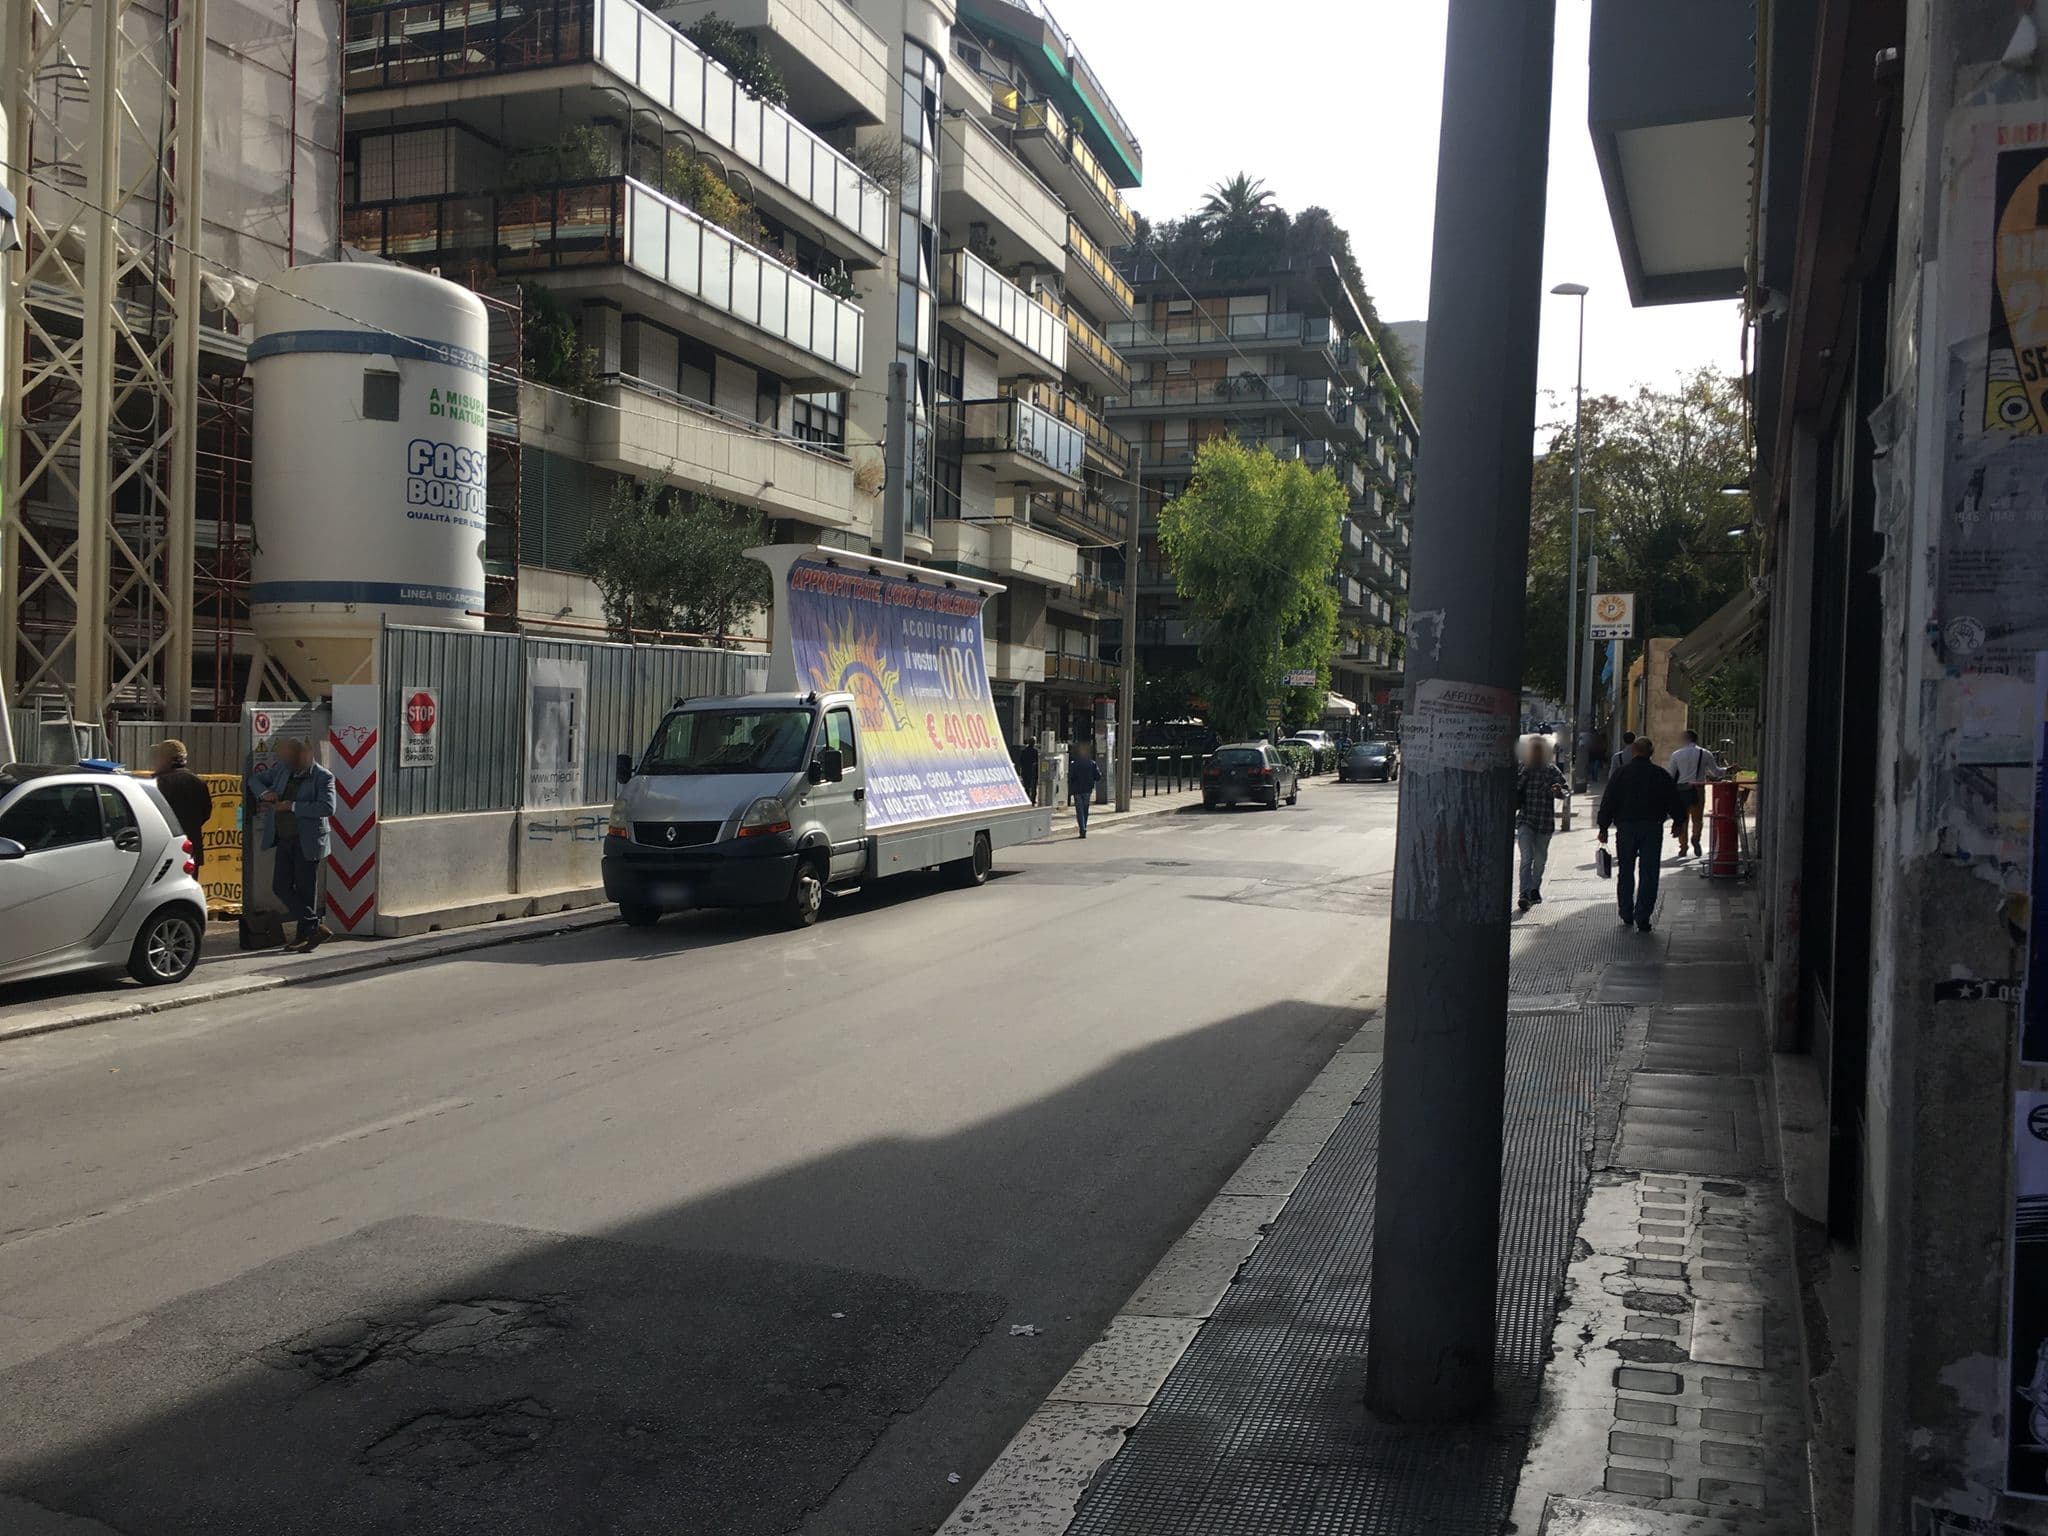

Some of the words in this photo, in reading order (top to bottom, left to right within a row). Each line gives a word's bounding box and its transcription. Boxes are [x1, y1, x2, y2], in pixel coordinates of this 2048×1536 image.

[430, 388, 440, 401] A
[430, 402, 445, 417] DI
[400, 588, 433, 599] LINEA
[902, 618, 974, 644] ACQUISTIAMO
[911, 648, 938, 672] vostro
[938, 645, 981, 701] ORO
[408, 705, 434, 722] STOP
[868, 774, 922, 794] MODUGNO
[883, 793, 937, 816] MOLFETTA
[938, 789, 970, 808] LECCE
